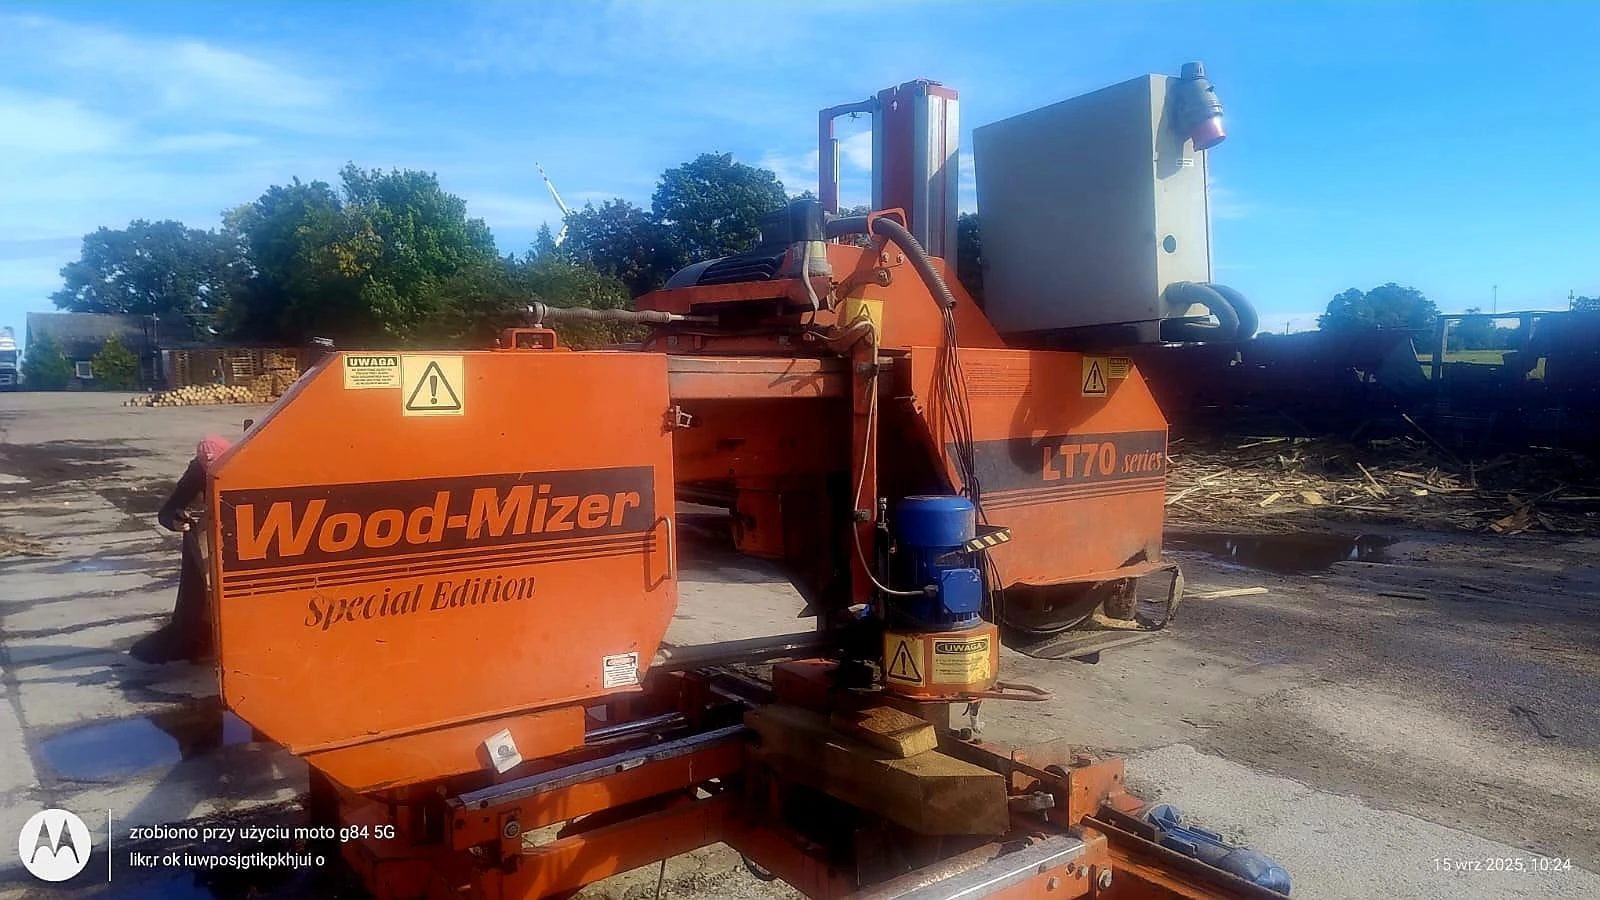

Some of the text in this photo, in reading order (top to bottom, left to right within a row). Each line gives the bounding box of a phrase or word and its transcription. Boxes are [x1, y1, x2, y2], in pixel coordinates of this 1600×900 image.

[349, 357, 396, 367] UWAGA
[1042, 442, 1163, 481] LT70 series
[235, 484, 640, 561] Wood-Mizer
[303, 575, 536, 632] Special Edition
[944, 640, 983, 652] UWAGA
